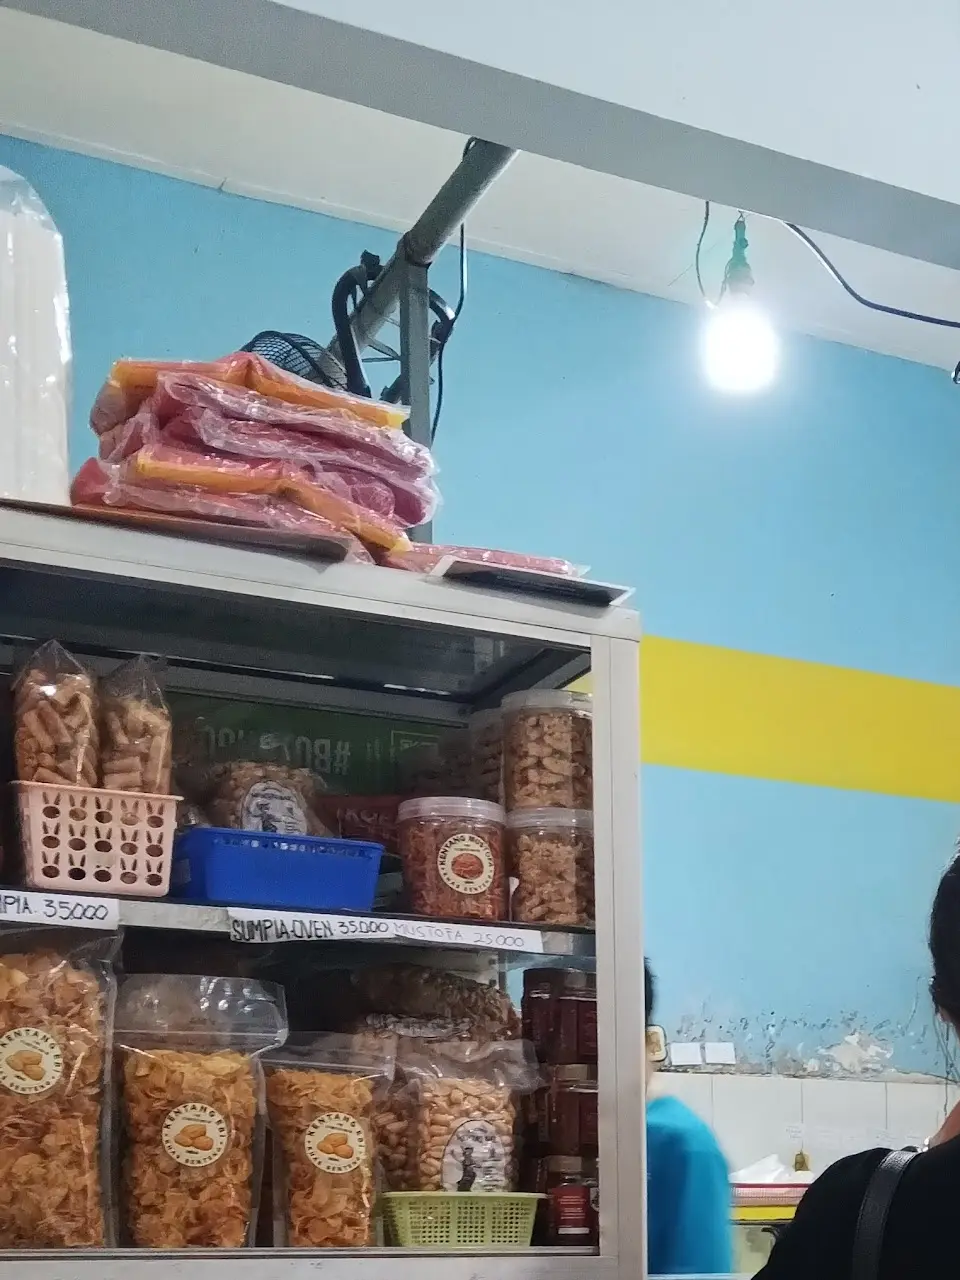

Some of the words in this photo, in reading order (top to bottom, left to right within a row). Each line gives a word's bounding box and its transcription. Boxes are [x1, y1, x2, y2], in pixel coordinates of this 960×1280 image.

[393, 921, 464, 941] MUSTOFA
[164, 1104, 216, 1129] KENTANG
[307, 1113, 357, 1136] KENTANG
